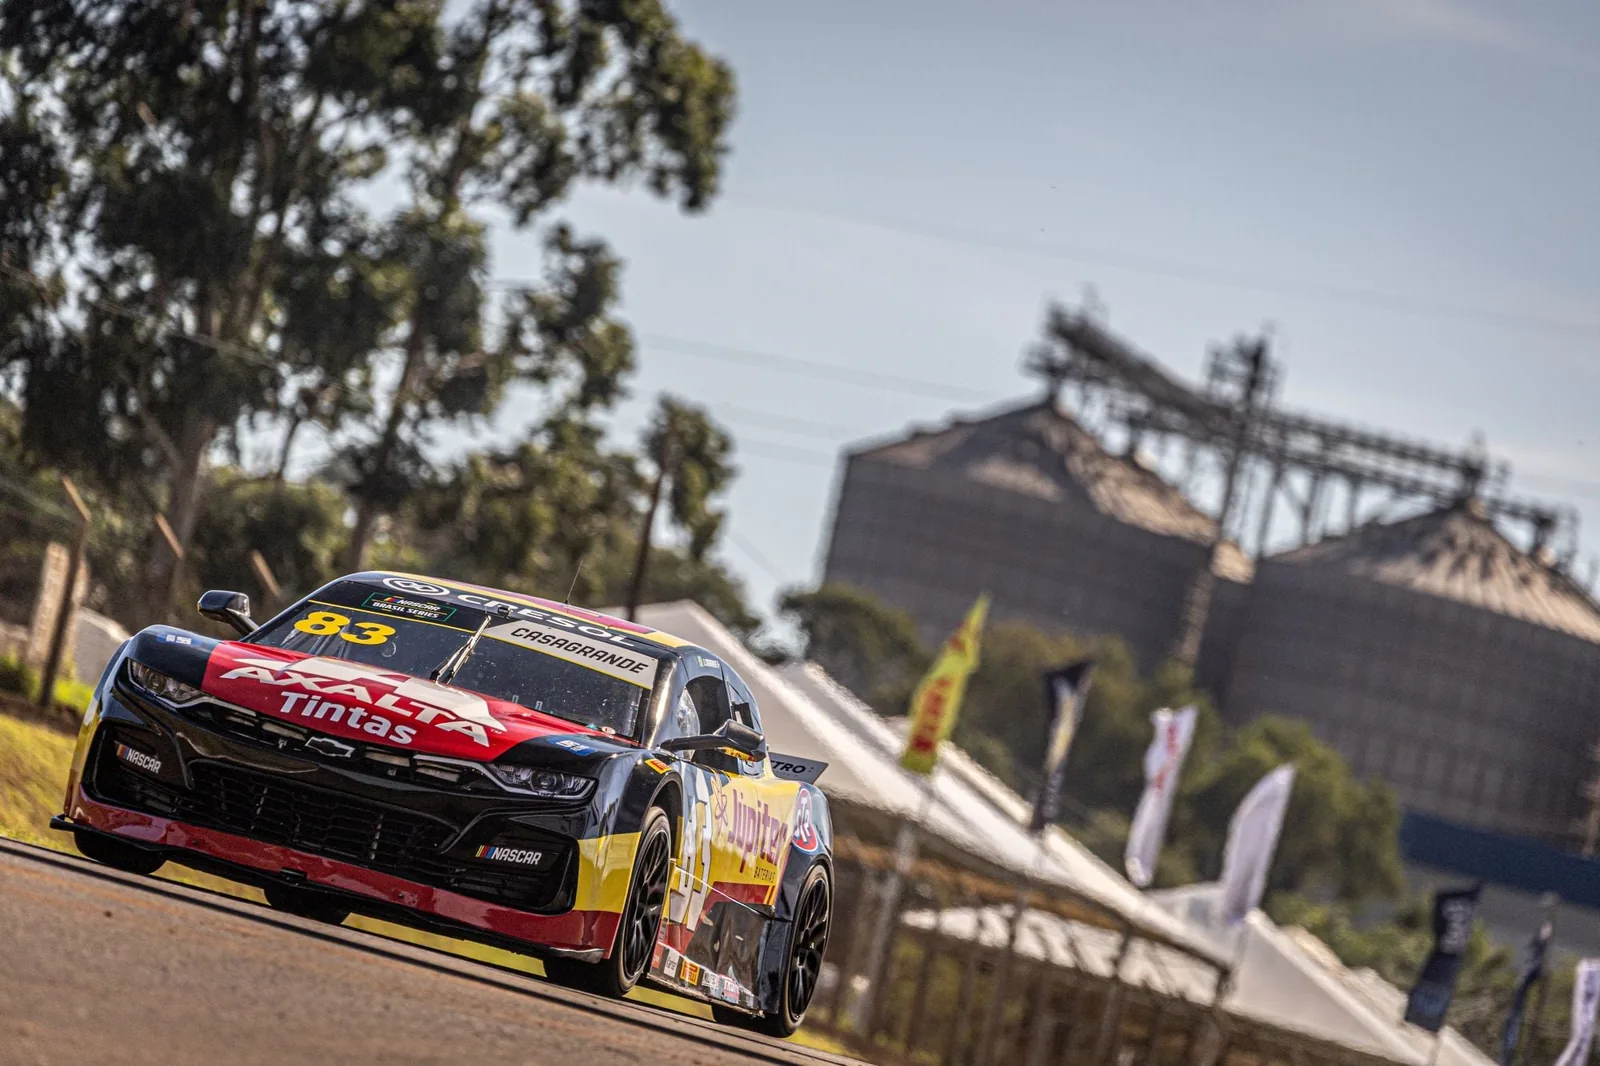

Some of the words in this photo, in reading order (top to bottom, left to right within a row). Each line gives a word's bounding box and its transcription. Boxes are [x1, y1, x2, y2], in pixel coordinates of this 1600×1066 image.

[372, 602, 405, 612] BRASIL
[406, 608, 439, 618] SERIES
[396, 599, 441, 611] NASCAR
[457, 595, 635, 647] CRESOL
[294, 611, 396, 645] 83
[511, 627, 649, 674] CASAGRANDE
[219, 666, 490, 748] AXALTA
[280, 691, 418, 745] Tintas
[126, 748, 161, 774] NASCAR
[491, 847, 542, 865] NASCAR
